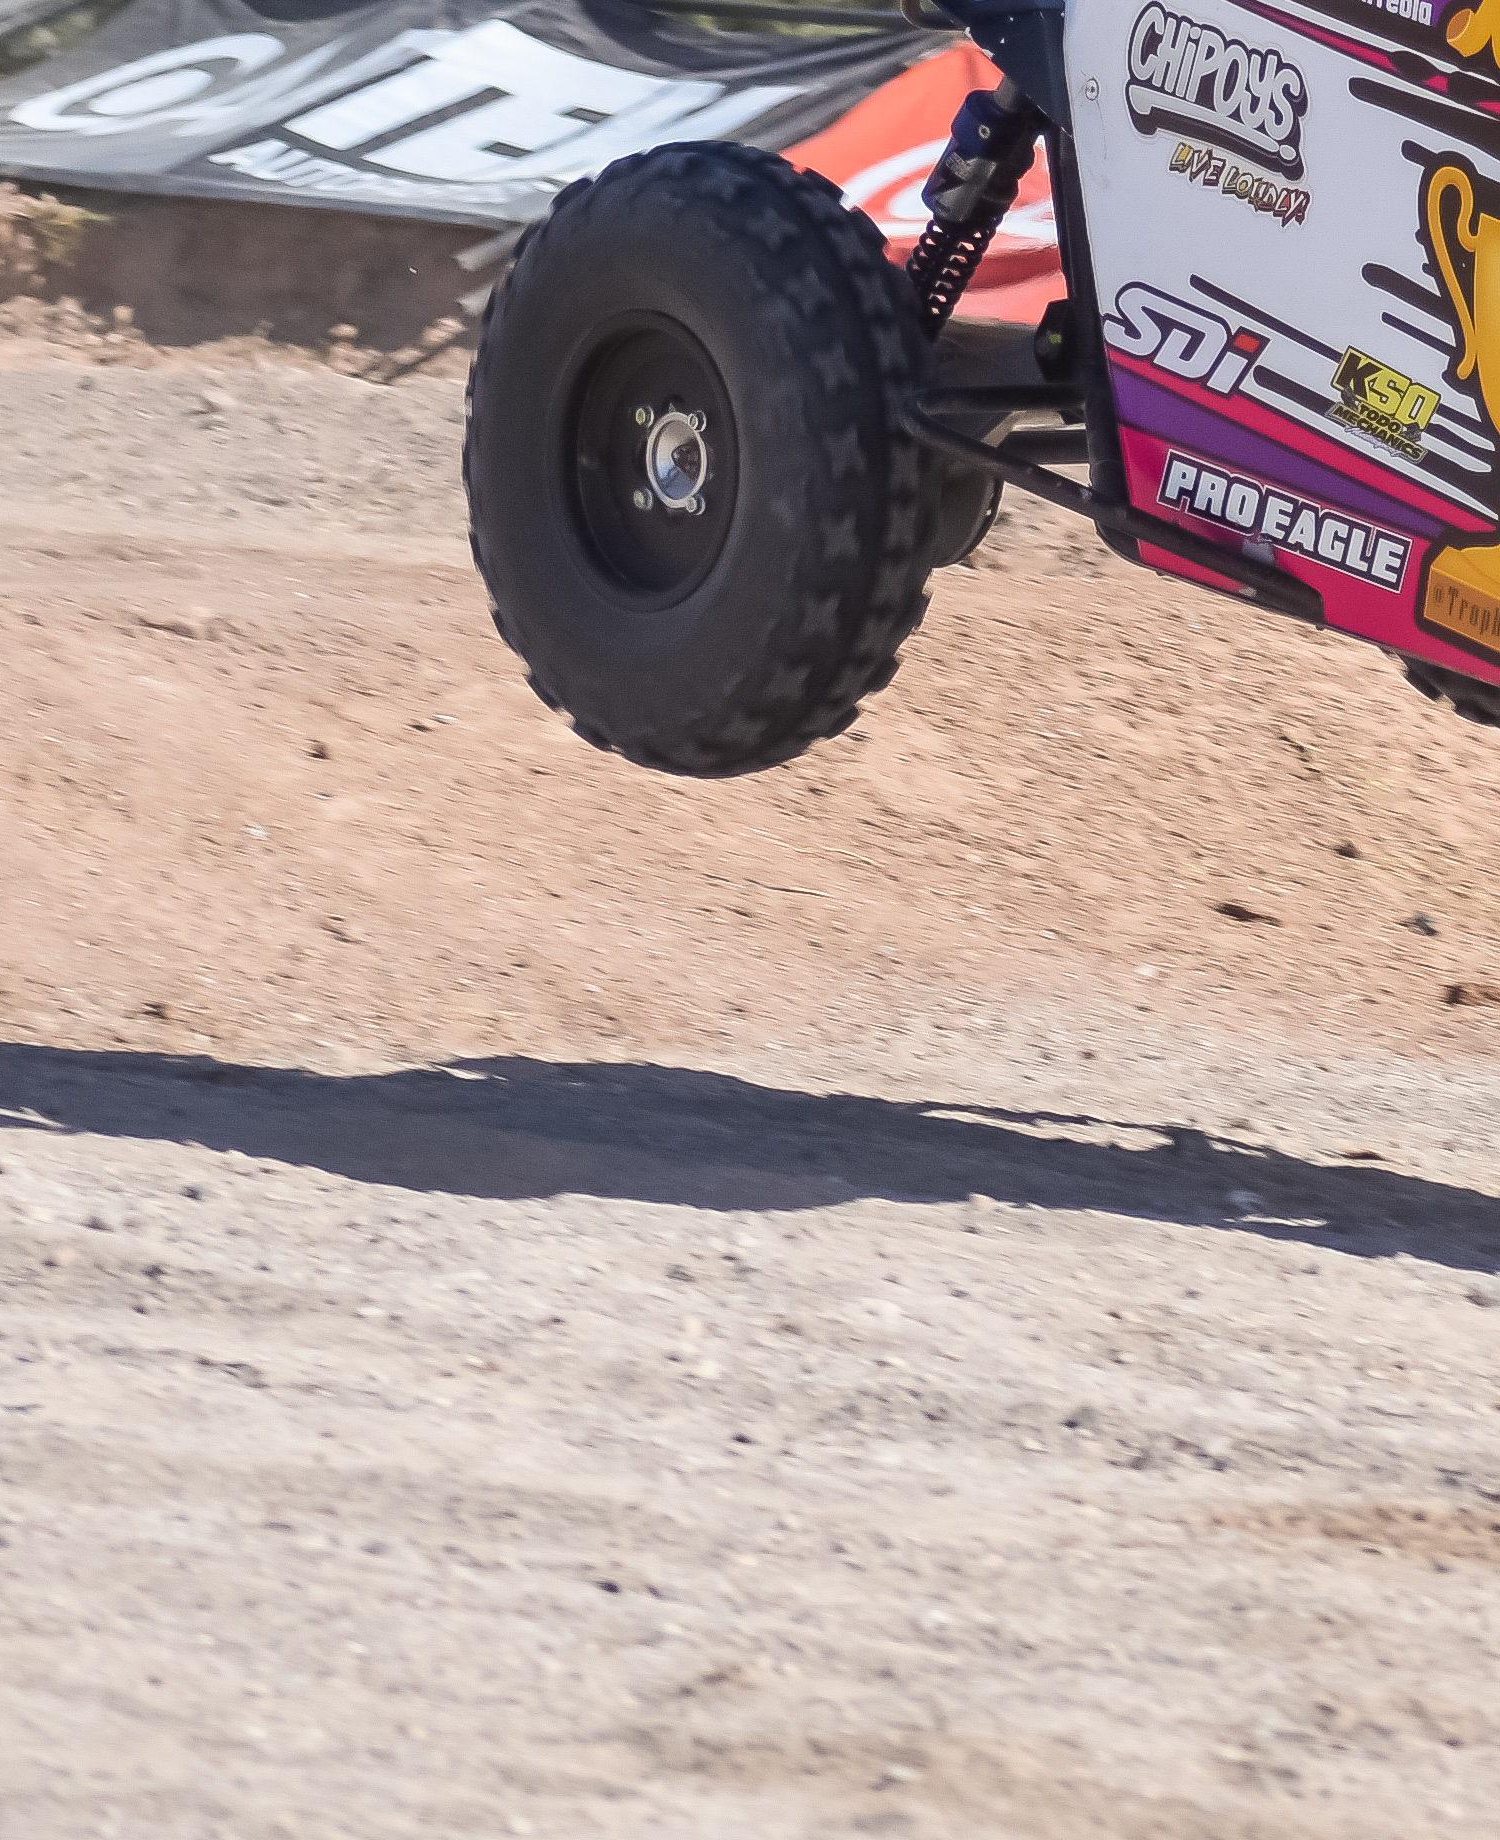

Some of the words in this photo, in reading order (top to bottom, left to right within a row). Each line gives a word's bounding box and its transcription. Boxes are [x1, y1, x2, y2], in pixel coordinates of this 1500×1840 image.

[1169, 142, 1226, 184] LIVE
[1331, 404, 1422, 460] MECHANICS
[1359, 403, 1402, 435] TODO
[1165, 460, 1260, 529] PRO
[1261, 495, 1405, 582] EAGLE
